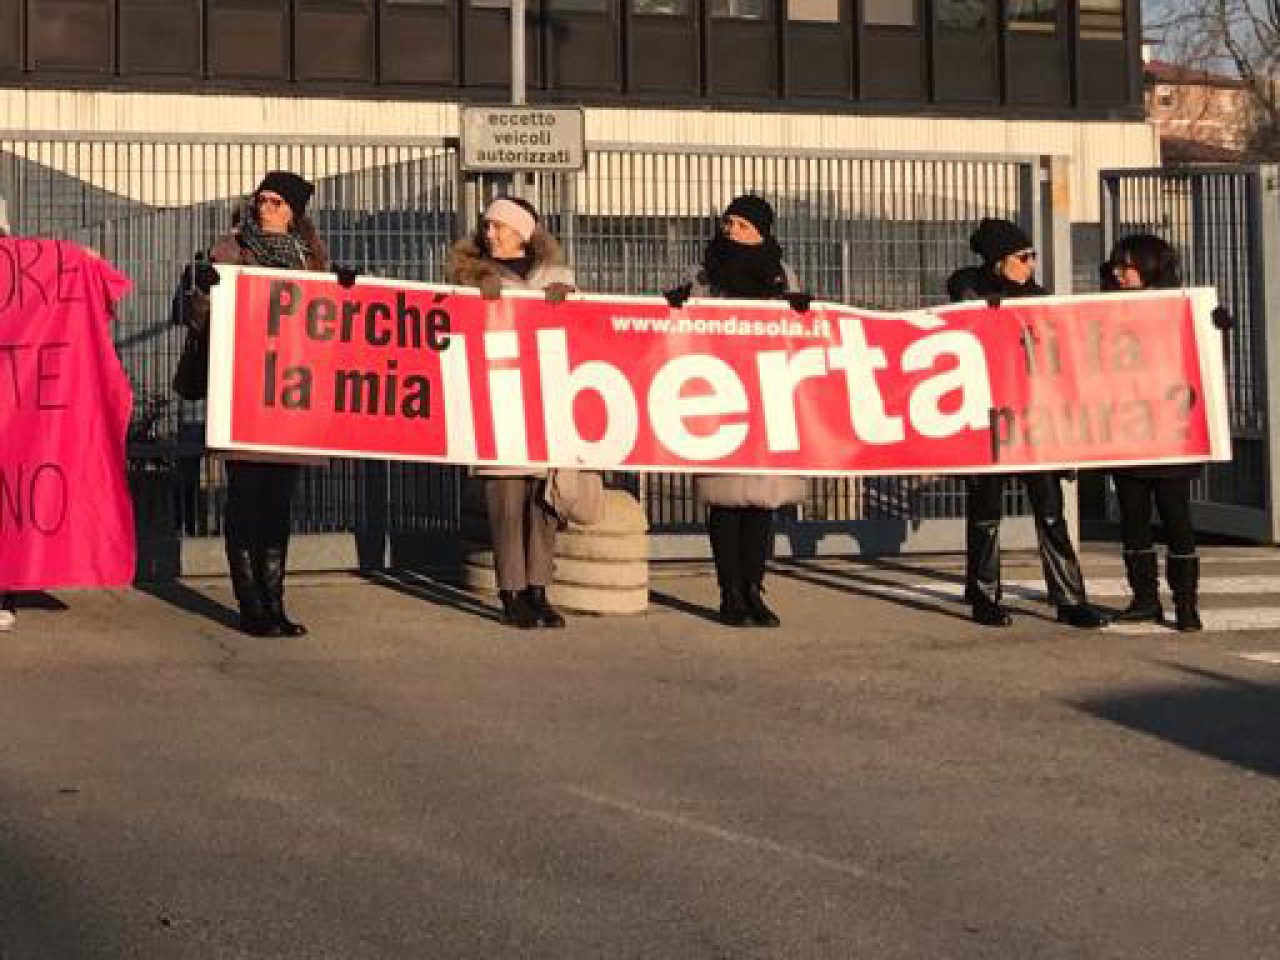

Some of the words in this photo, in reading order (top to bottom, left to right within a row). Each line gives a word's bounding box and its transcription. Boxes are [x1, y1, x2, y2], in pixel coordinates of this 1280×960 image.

[487, 113, 556, 126] eccetto
[494, 130, 551, 146] veicoli
[477, 149, 570, 163] autorizzati
[267, 280, 452, 352] Perché
[611, 315, 832, 339] www.nondasola.it
[1021, 323, 1061, 377] ti
[263, 351, 312, 411] la
[333, 359, 432, 420] mia
[439, 313, 993, 465] libertà
